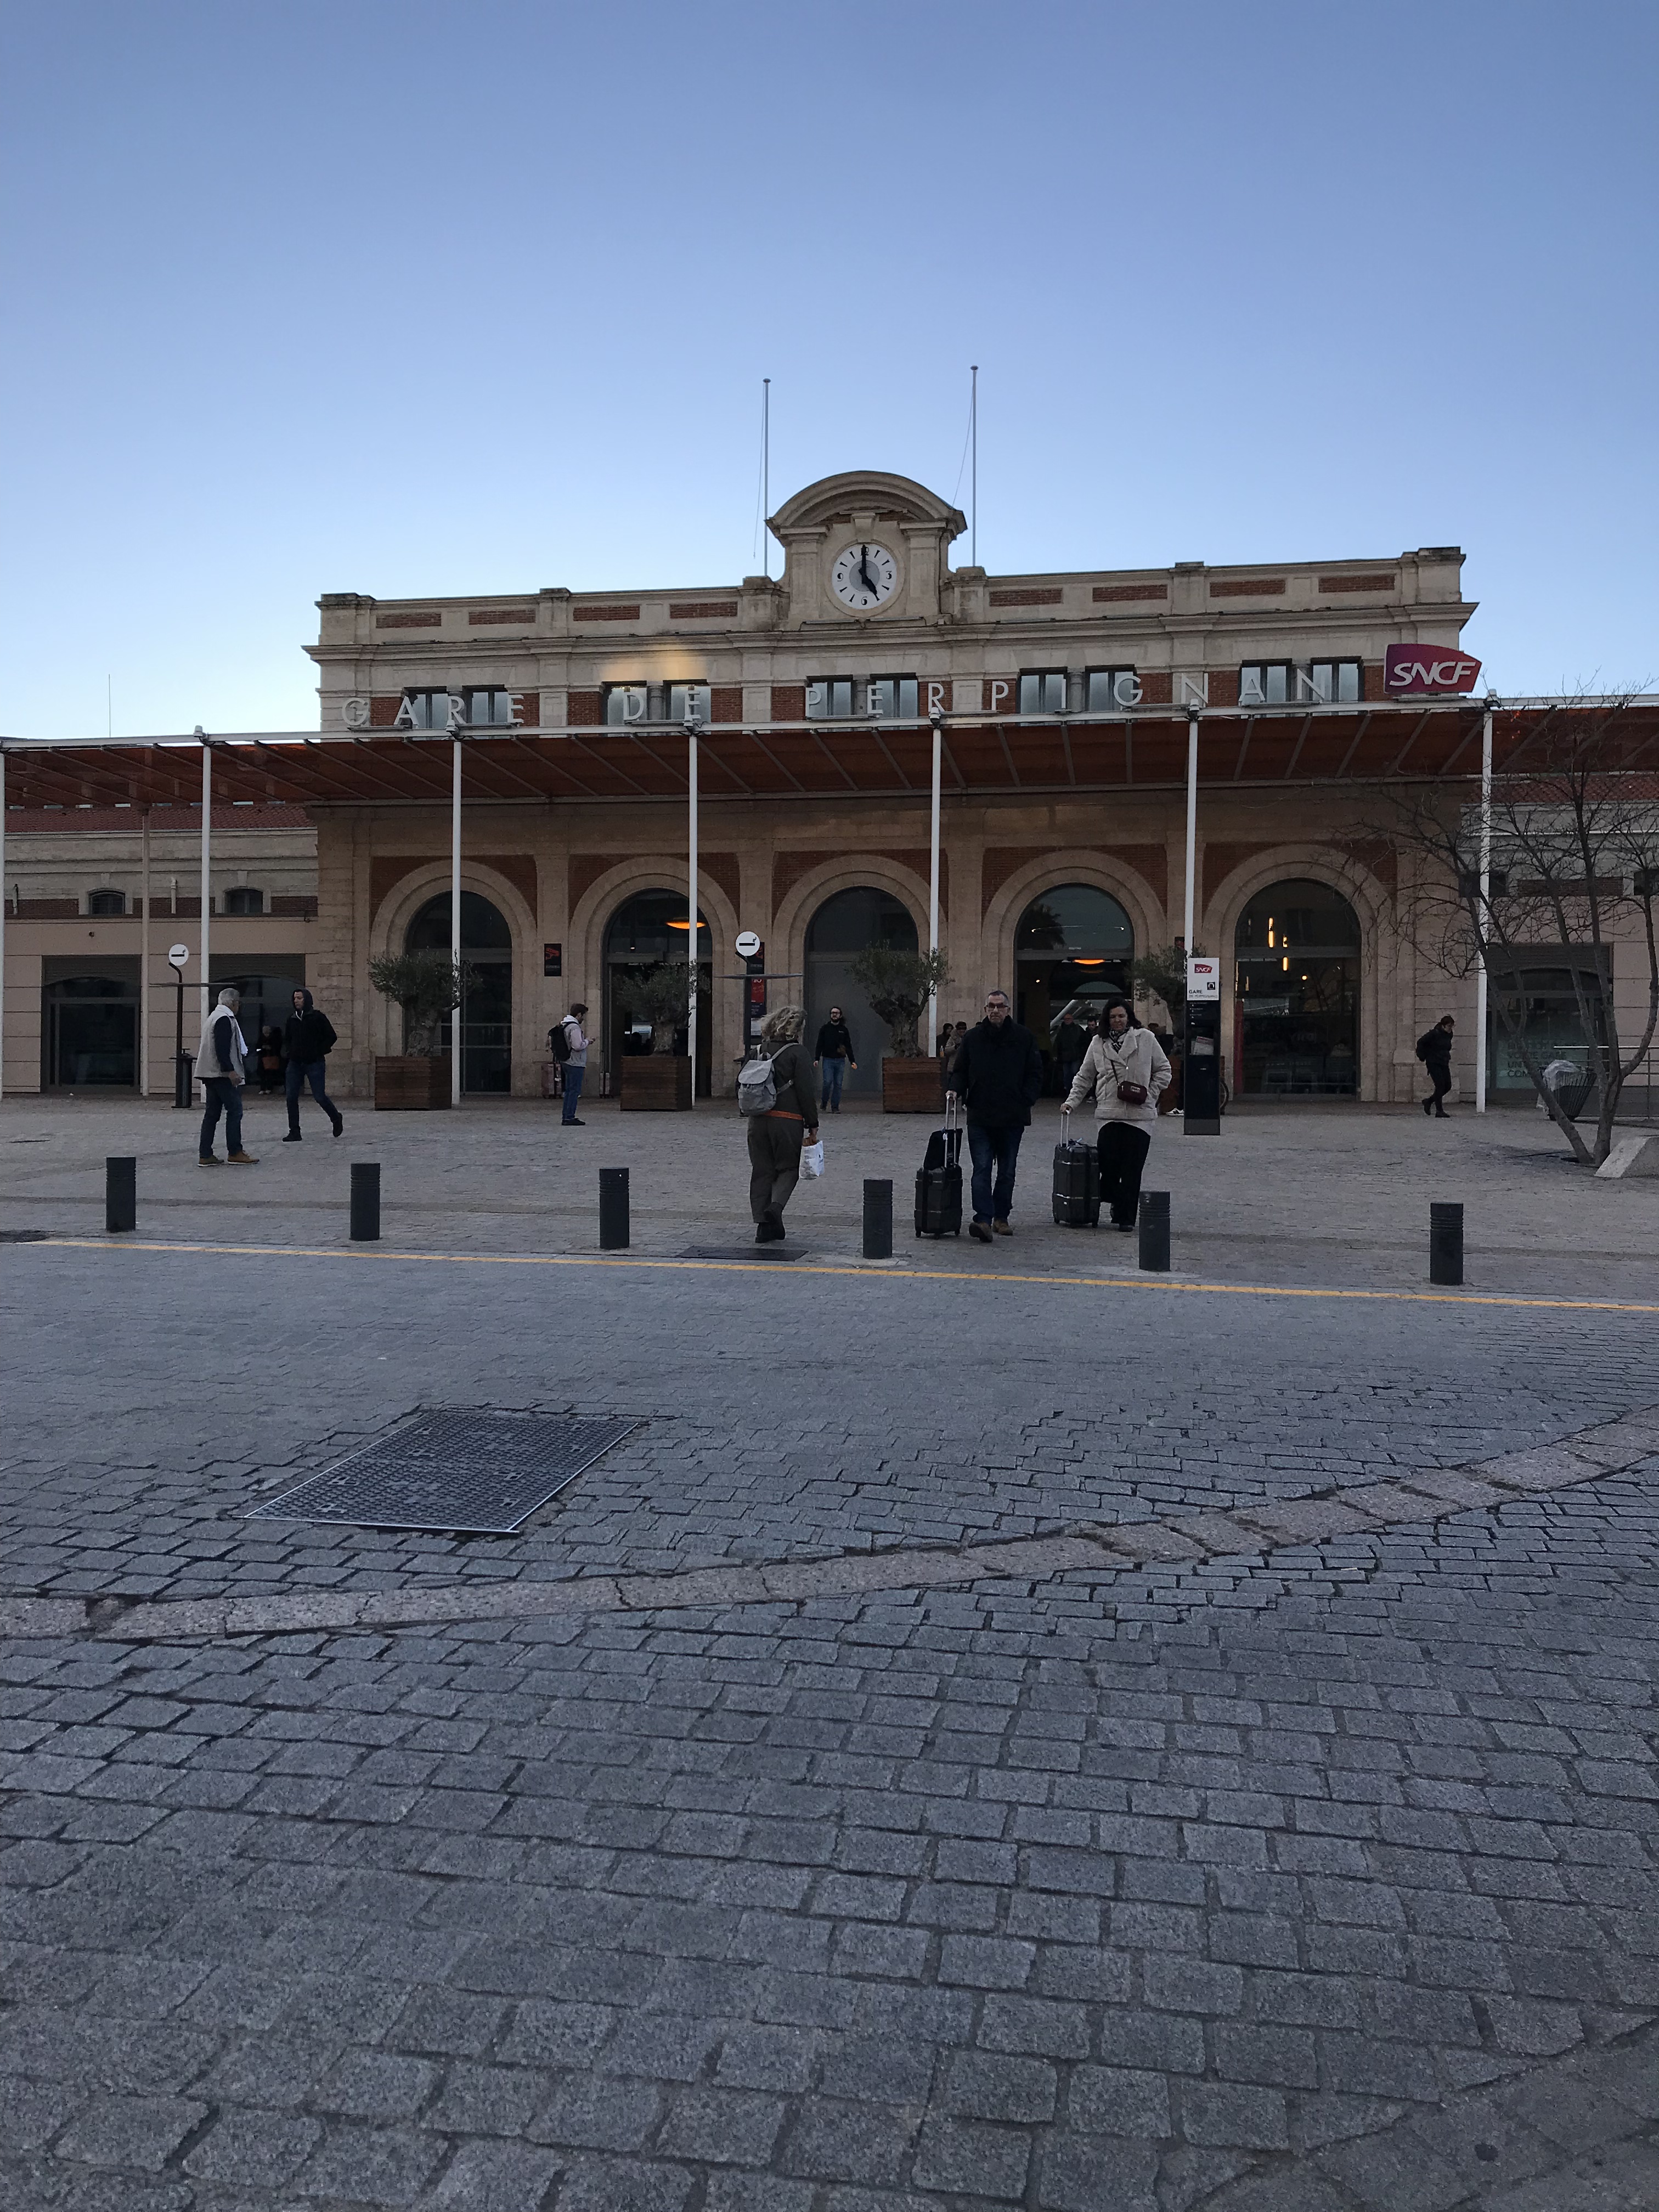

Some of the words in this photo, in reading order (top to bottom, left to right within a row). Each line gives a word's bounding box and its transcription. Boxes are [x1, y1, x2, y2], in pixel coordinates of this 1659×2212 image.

[886, 571, 892, 579] 3
[861, 596, 867, 605] 6
[1389, 661, 1476, 686] SNCF
[342, 693, 525, 726] GARE
[622, 690, 701, 721] DE
[804, 675, 1325, 715] PERPIGNAN
